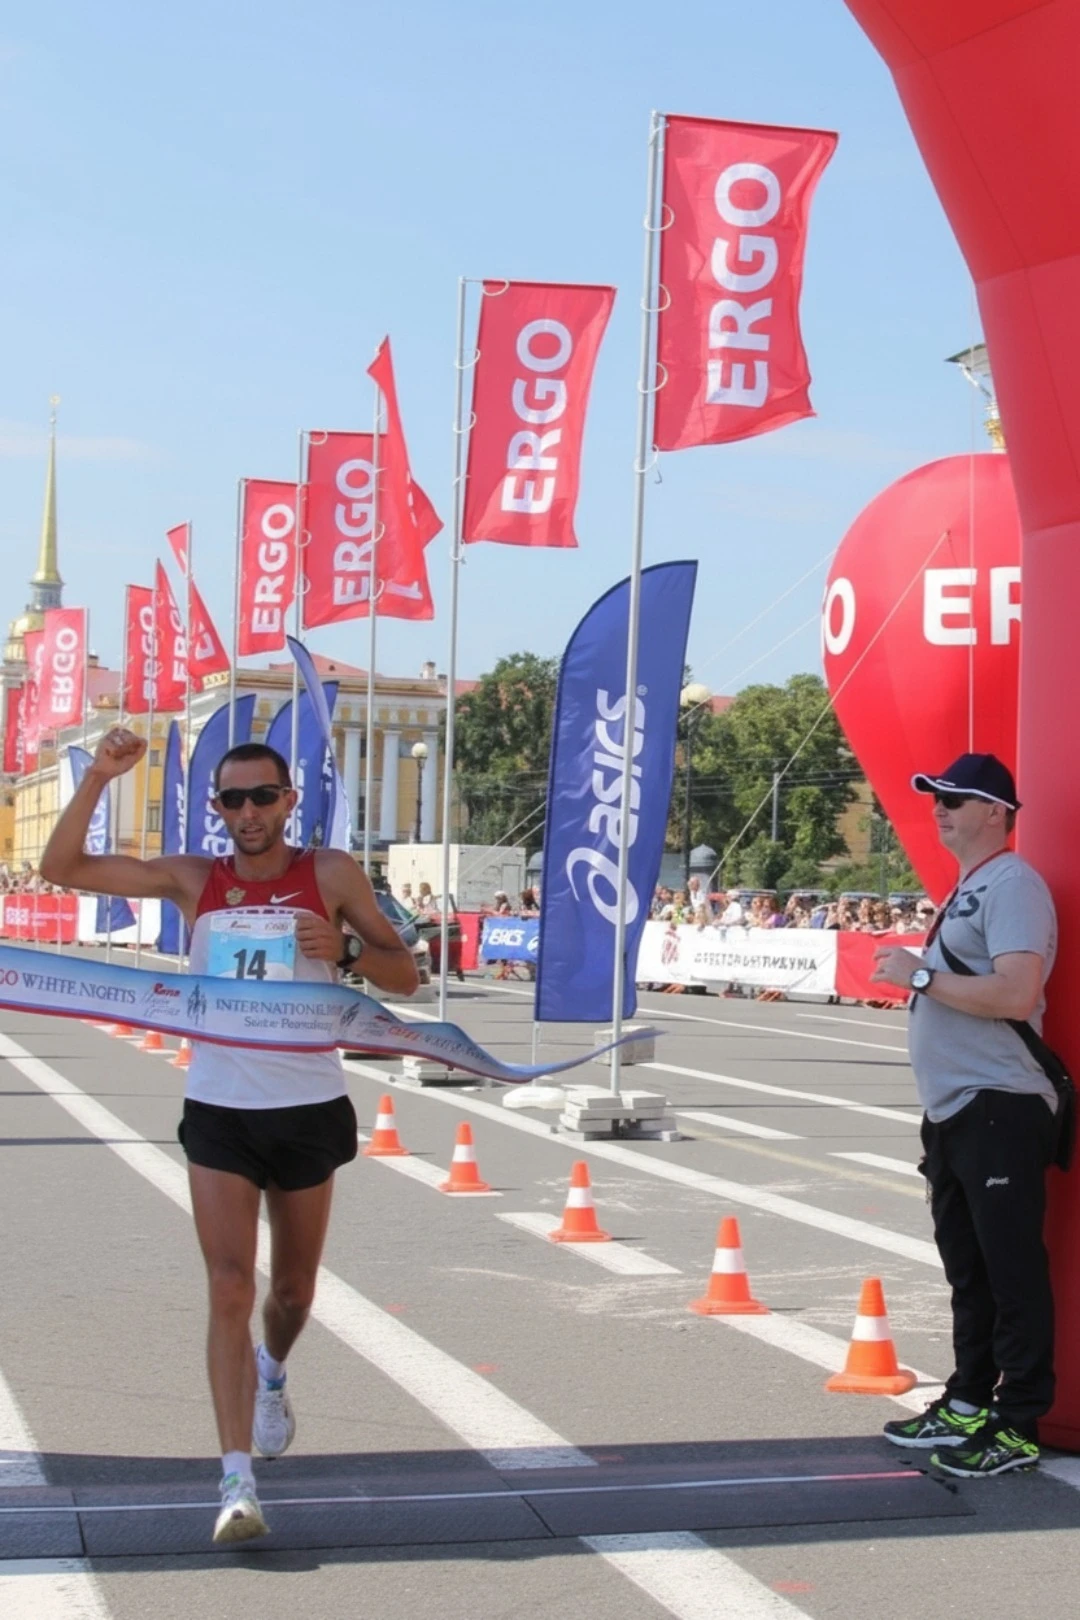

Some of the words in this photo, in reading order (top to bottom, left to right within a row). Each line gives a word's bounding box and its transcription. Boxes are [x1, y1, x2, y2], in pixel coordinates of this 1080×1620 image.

[704, 162, 782, 409] ERGO
[501, 318, 573, 515] ERGO
[251, 503, 295, 634] ERGO
[332, 458, 376, 605] ERGO
[820, 577, 856, 655] O
[588, 688, 646, 849] asics
[233, 948, 267, 980] 14
